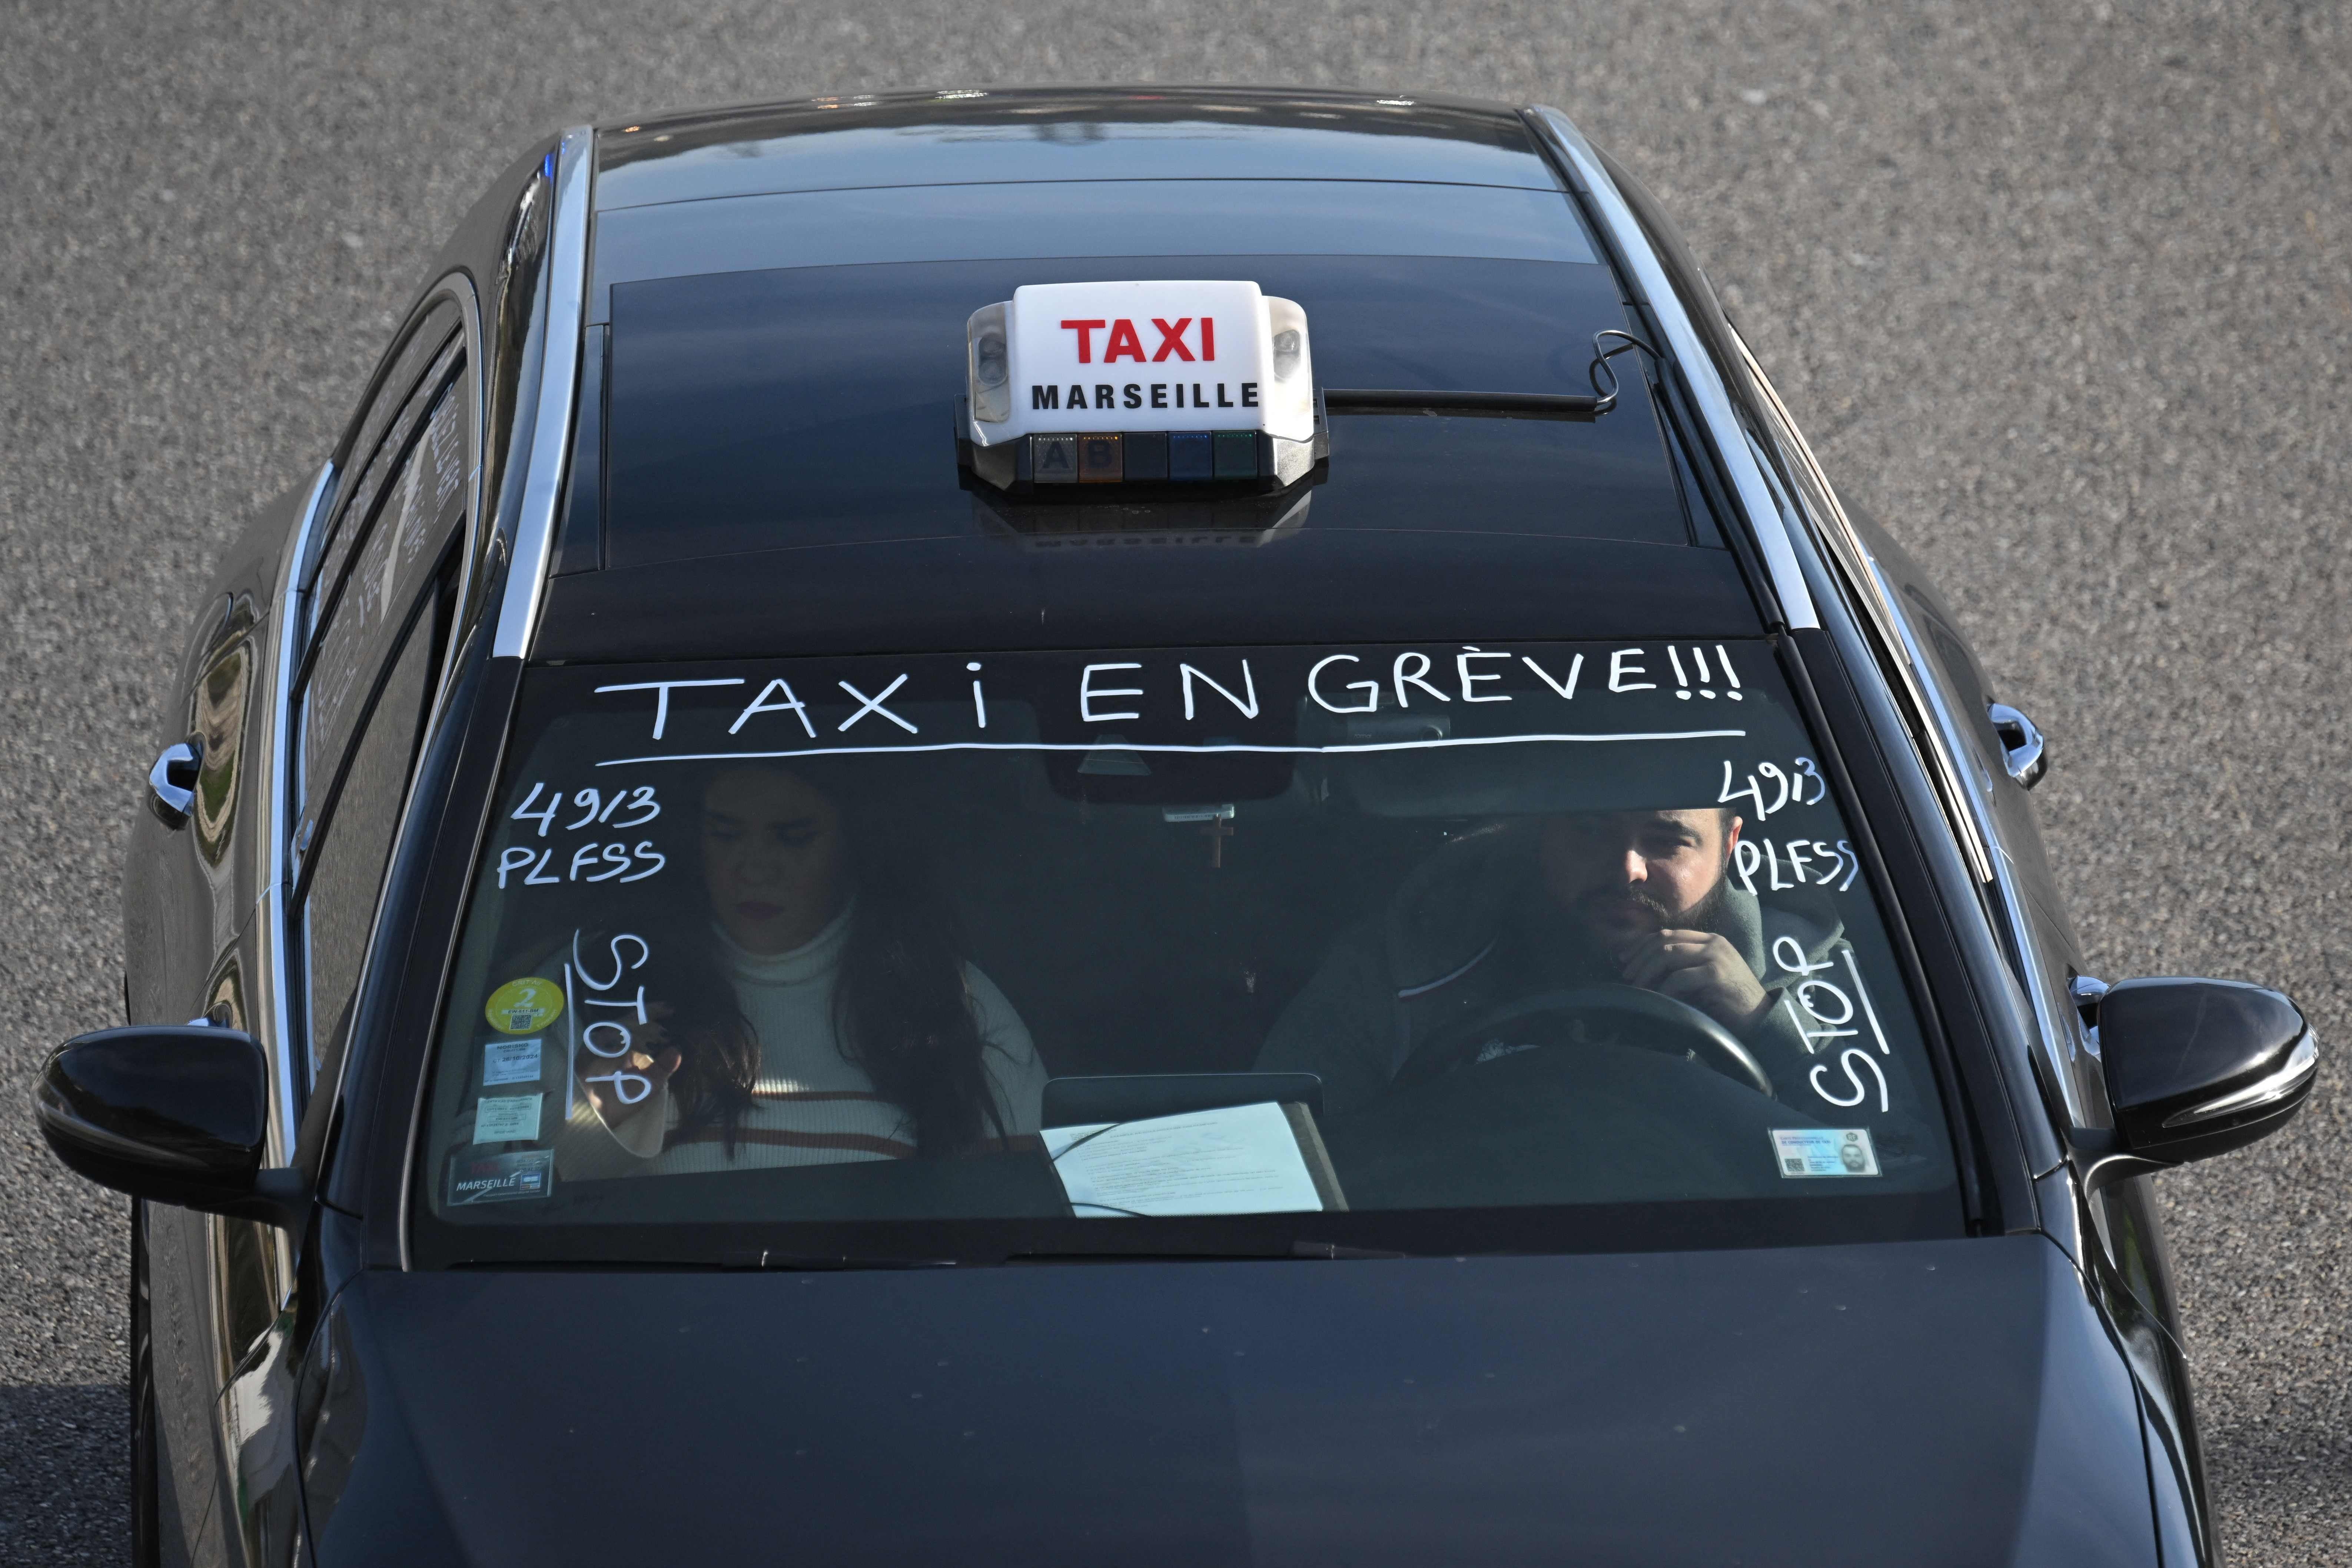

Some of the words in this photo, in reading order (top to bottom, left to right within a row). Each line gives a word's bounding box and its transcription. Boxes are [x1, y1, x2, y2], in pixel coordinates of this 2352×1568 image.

[1061, 317, 1215, 363] TAXI
[1032, 382, 1259, 410] MARSEILLE
[1042, 441, 1069, 469] A
[1088, 440, 1112, 468] B
[1080, 658, 1259, 722] EN
[1308, 644, 1742, 714] GRÈVE!!!
[497, 841, 665, 889] PLFSS
[1734, 838, 1858, 896] PLFSS
[514, 988, 536, 1007] 2
[573, 928, 652, 1104] STOP
[1773, 936, 1888, 1112] STOP
[456, 1177, 516, 1192] MARSEILLE
